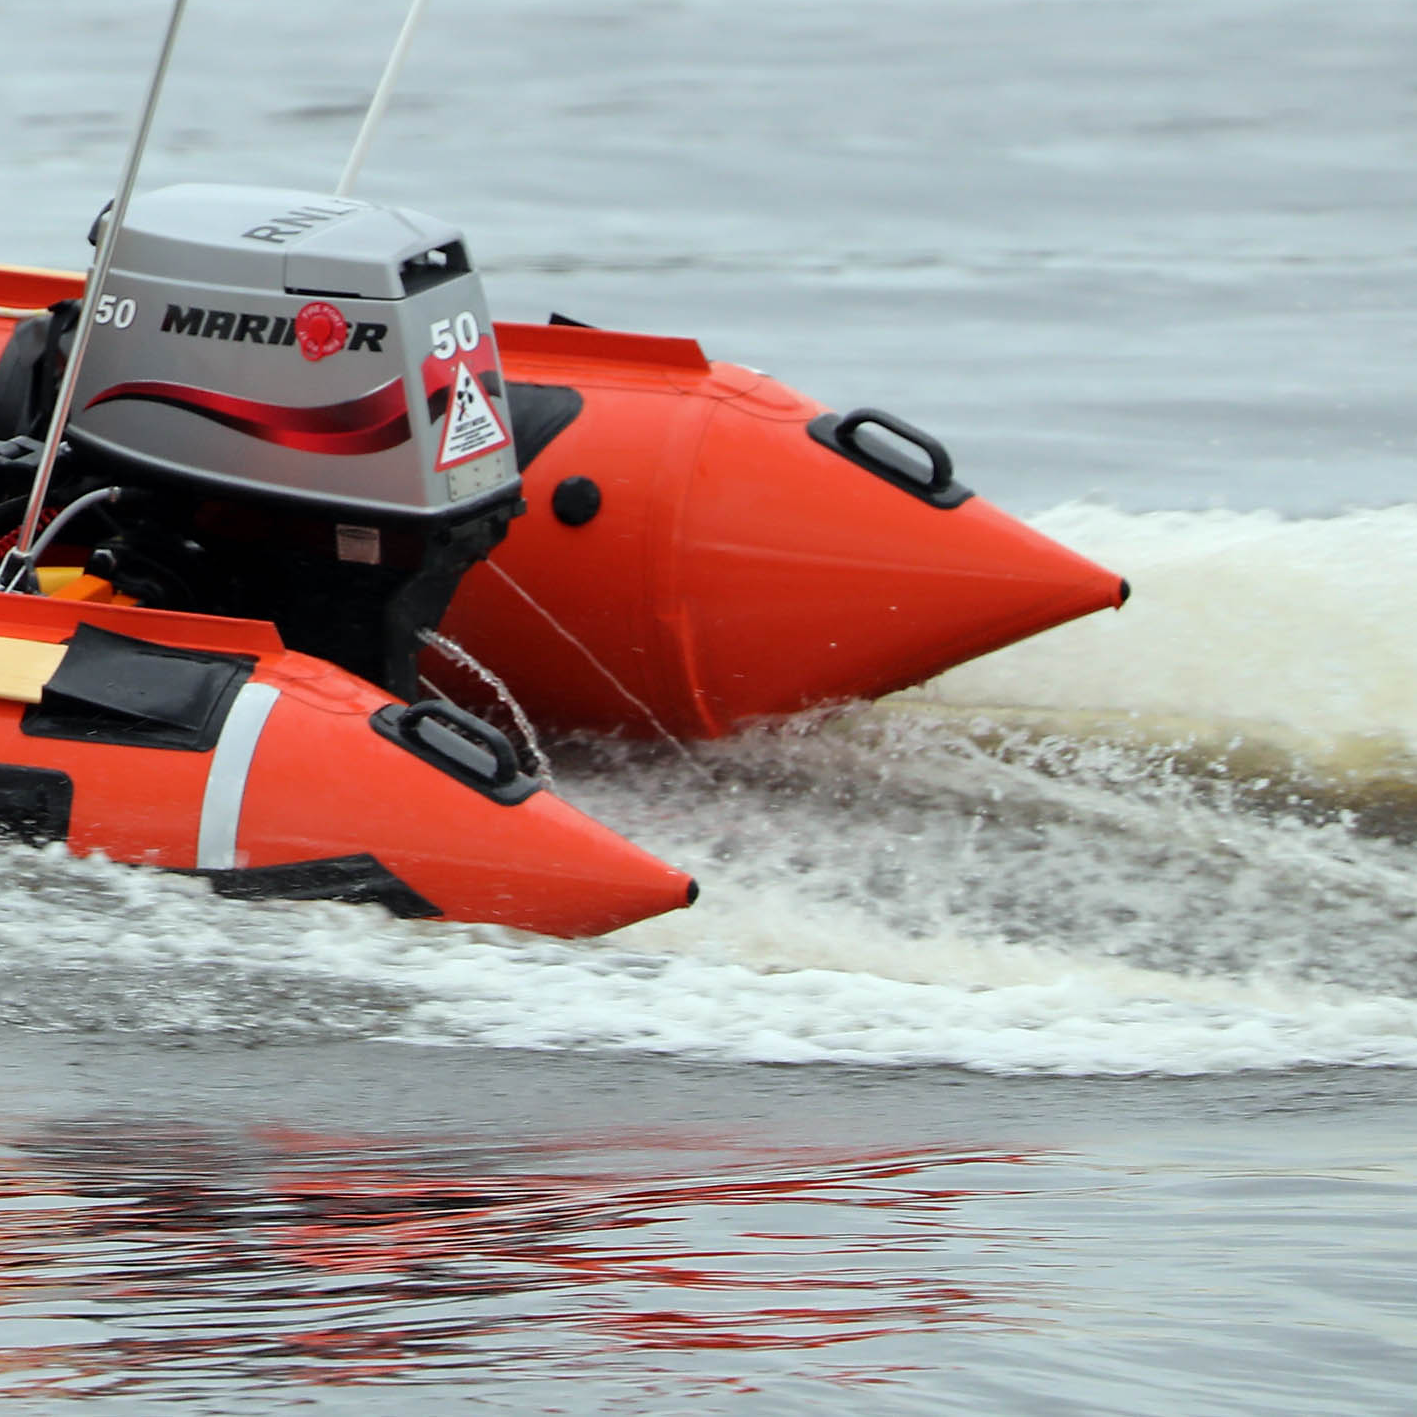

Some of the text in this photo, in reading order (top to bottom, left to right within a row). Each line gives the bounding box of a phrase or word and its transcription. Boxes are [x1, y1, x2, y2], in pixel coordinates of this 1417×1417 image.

[94, 294, 137, 330] 50
[161, 303, 388, 353] MARIR
[430, 311, 480, 360] 50
